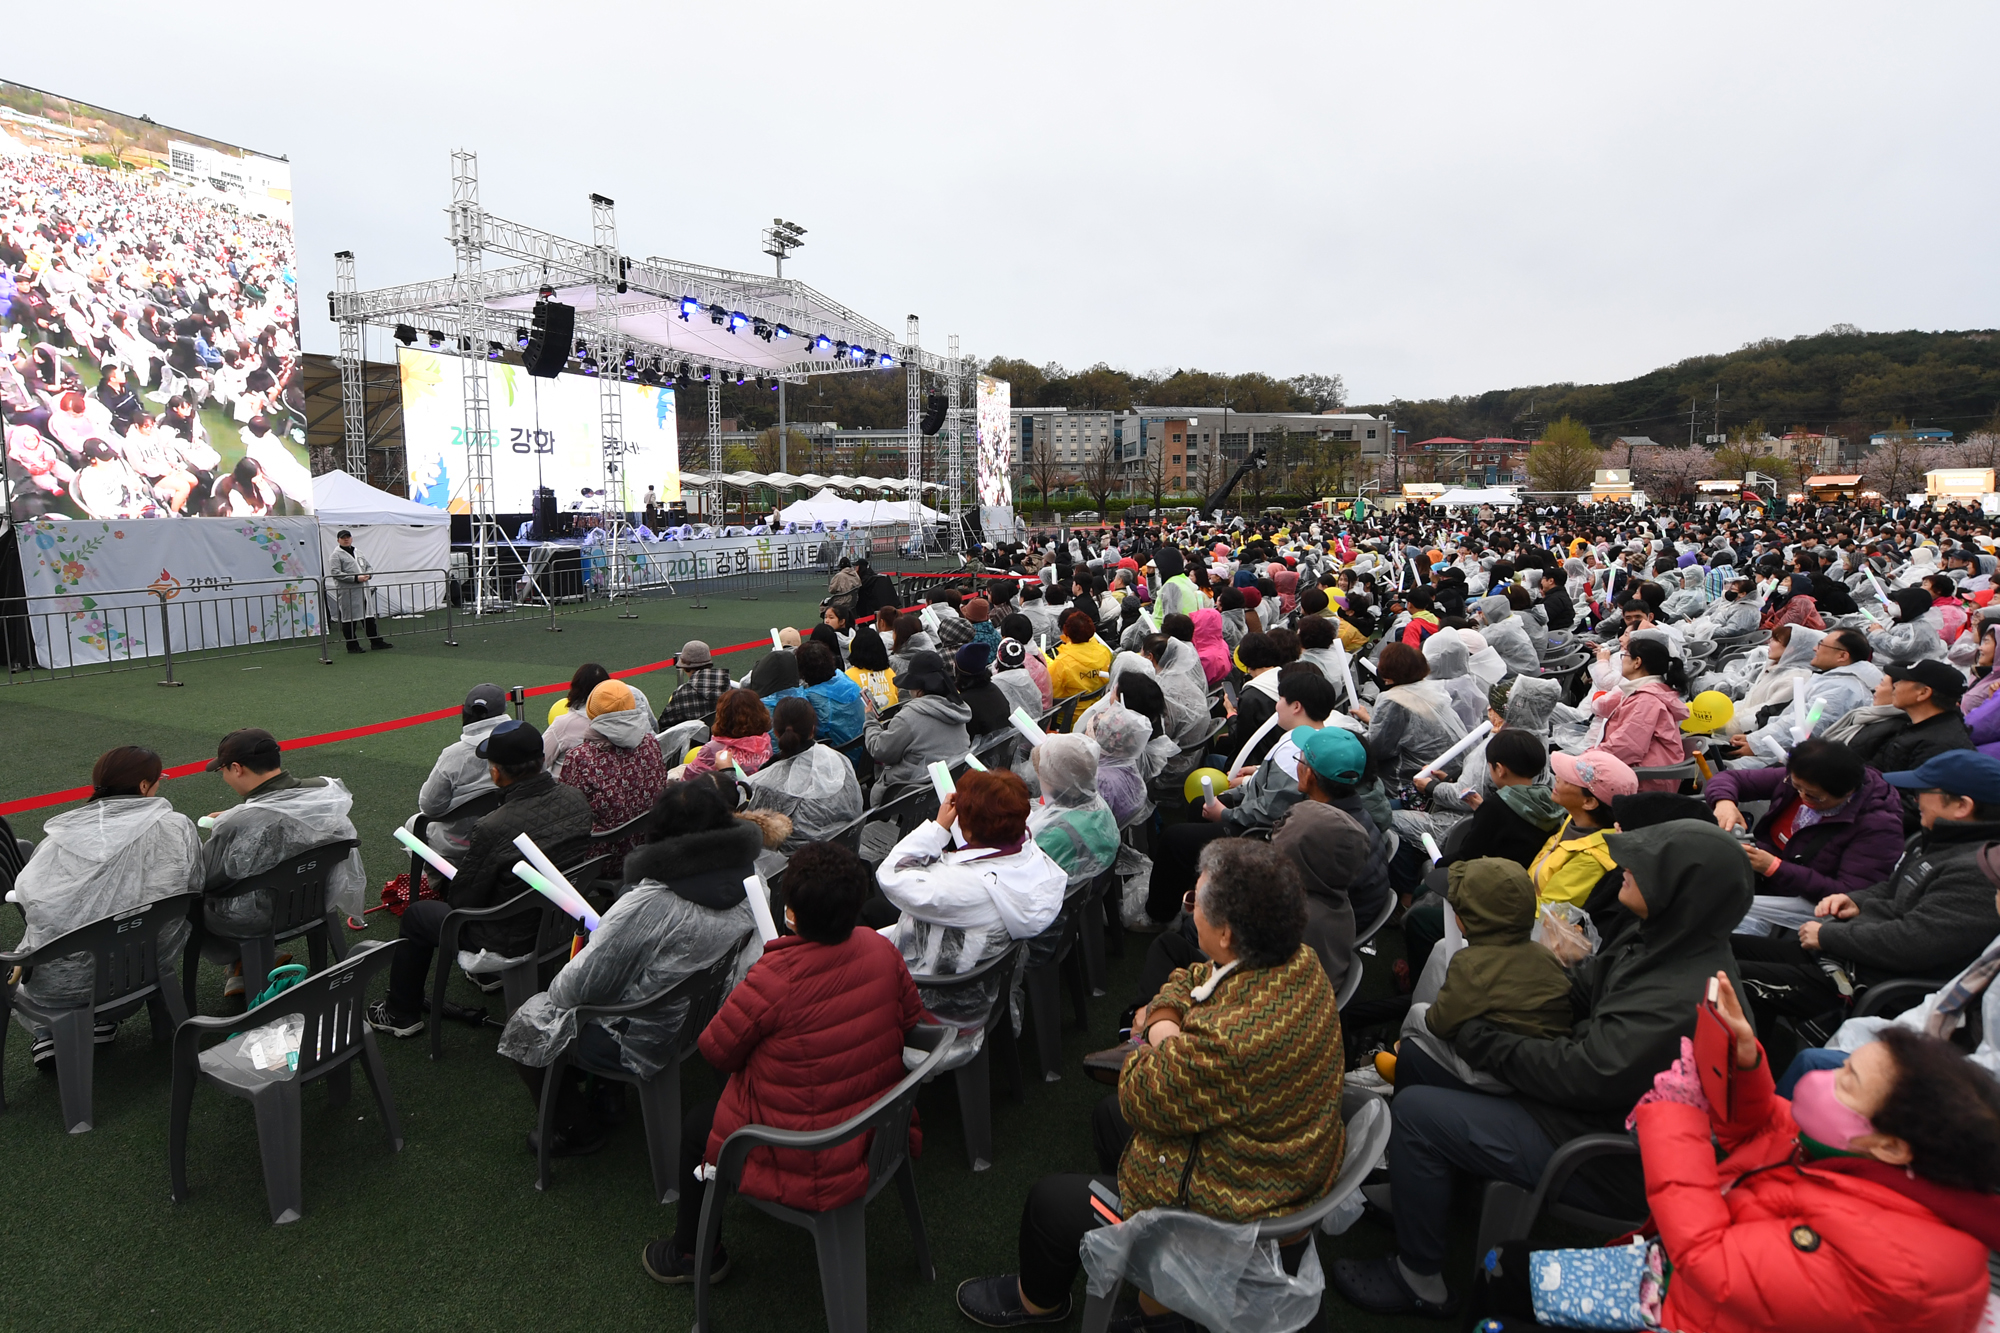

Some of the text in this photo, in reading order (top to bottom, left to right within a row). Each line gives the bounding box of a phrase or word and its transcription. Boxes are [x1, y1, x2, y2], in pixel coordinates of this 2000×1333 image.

[510, 427, 555, 455] 강화
[668, 556, 708, 577] 2025
[715, 549, 750, 574] 강화
[296, 860, 317, 874] ES
[116, 917, 143, 934] ES
[328, 971, 355, 991] ES
